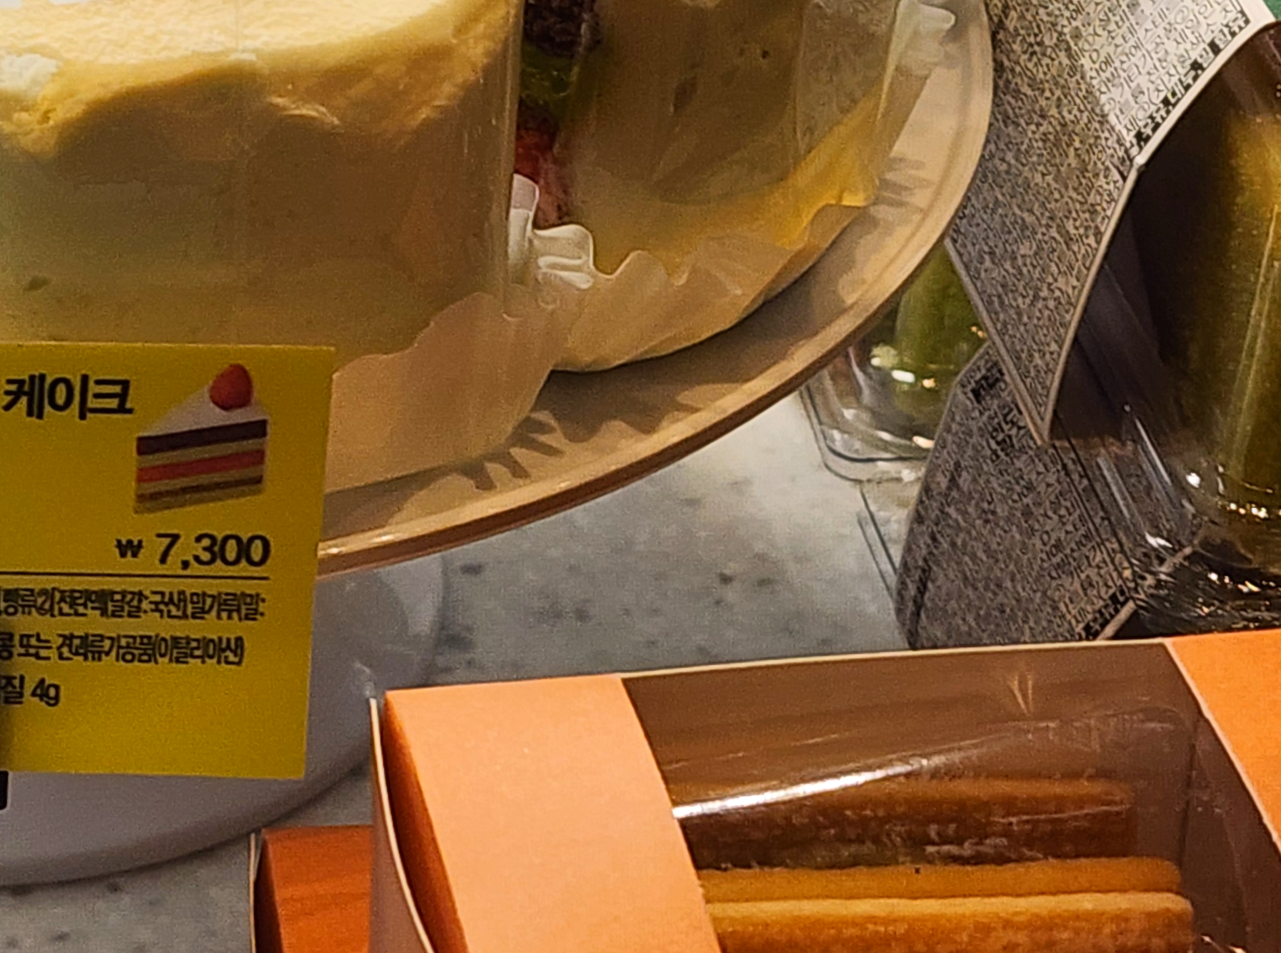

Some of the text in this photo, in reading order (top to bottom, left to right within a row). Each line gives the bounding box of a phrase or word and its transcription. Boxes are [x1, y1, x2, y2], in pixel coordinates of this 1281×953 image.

[2, 372, 134, 420] 케이크
[155, 532, 271, 571] 7,300
[17, 632, 52, 660] 또는
[30, 677, 60, 707] 4g
